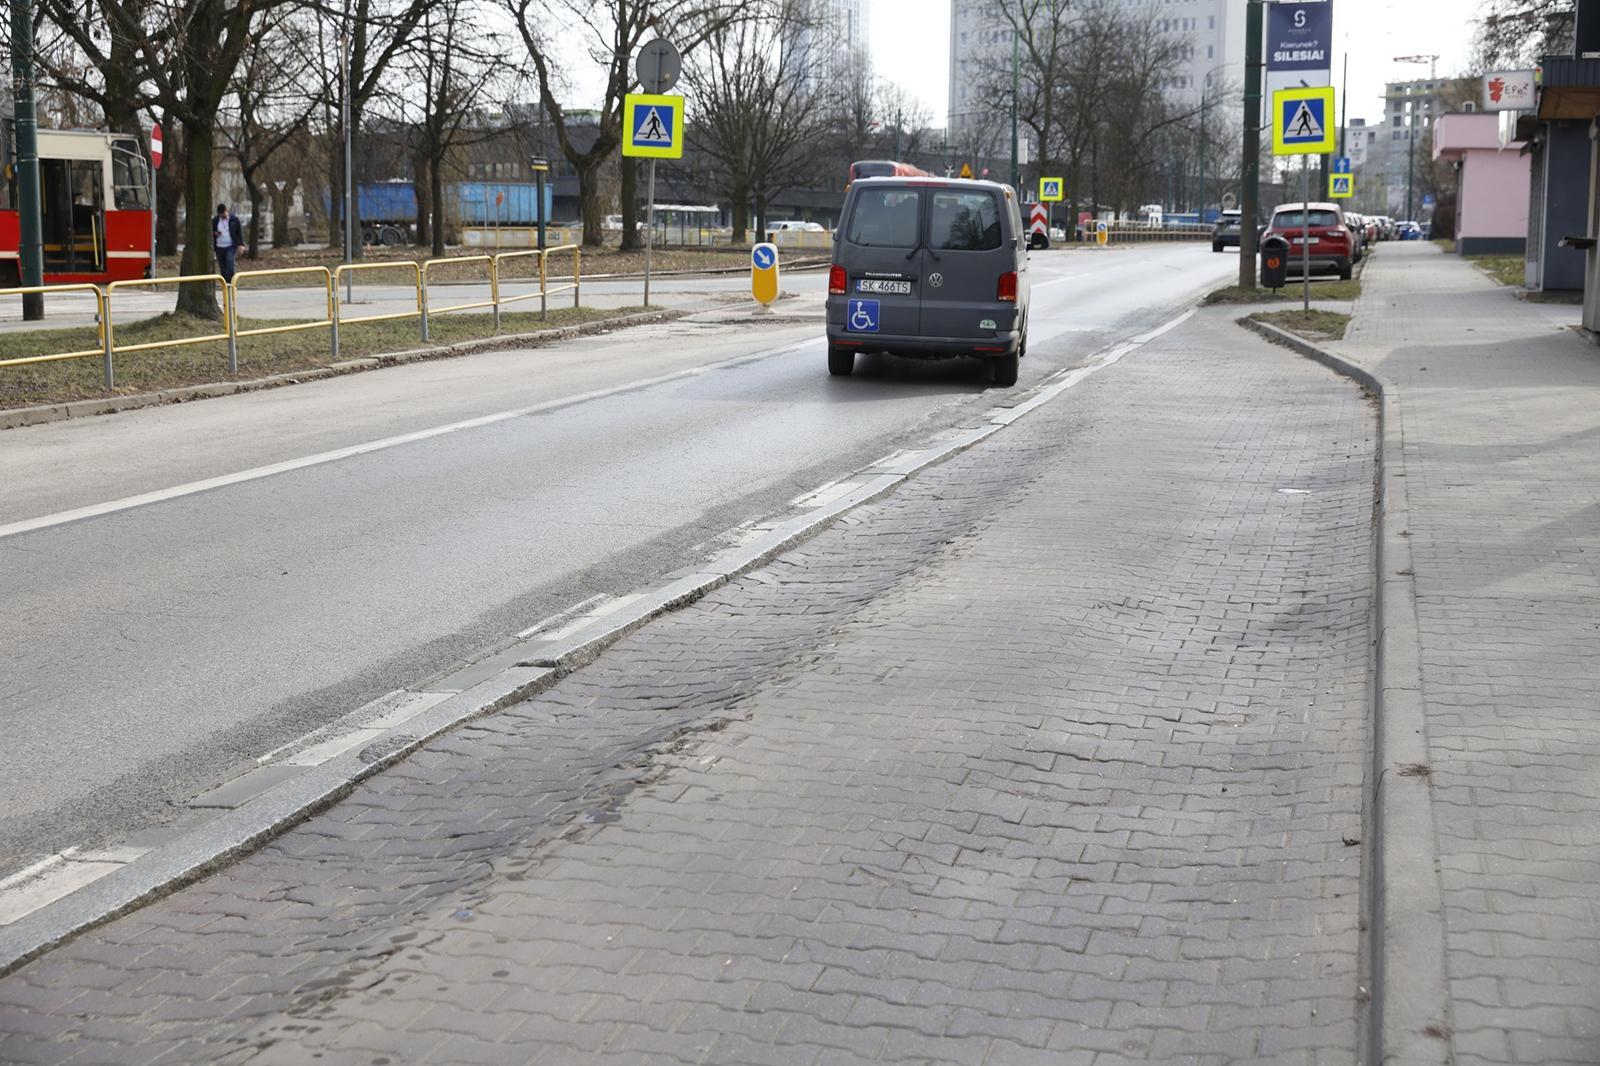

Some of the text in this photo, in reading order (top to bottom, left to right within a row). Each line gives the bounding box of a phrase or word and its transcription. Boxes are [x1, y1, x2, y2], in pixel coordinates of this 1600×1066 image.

[1274, 50, 1324, 61] SILESIA!
[862, 280, 908, 292] SK 466TS
